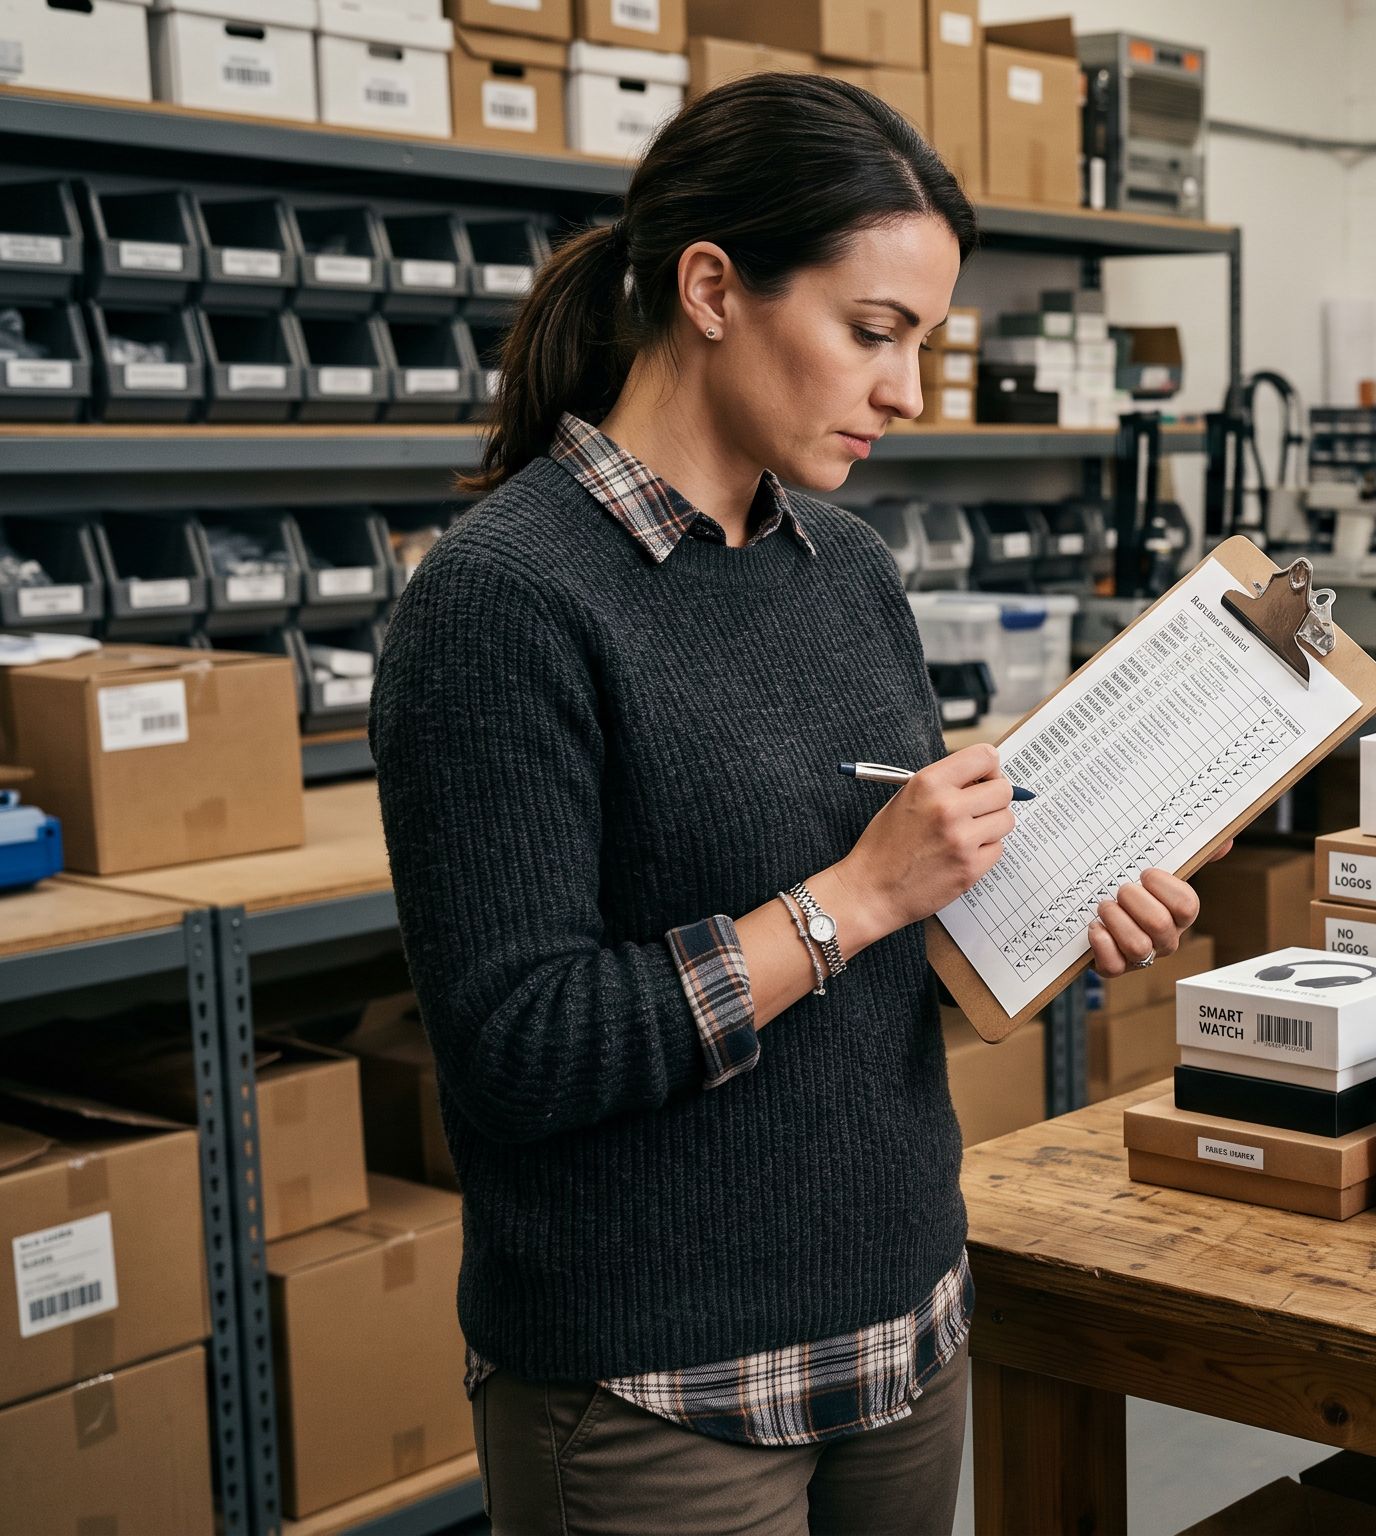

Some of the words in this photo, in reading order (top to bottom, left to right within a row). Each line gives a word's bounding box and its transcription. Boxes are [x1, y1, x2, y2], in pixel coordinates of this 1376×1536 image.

[1341, 862, 1357, 874] NO
[1335, 876, 1372, 890] LOGOS
[1338, 928, 1354, 940] NO
[1332, 942, 1369, 956] LOGOS
[1199, 1005, 1244, 1023] SMART
[1199, 1021, 1244, 1040] WATCH
